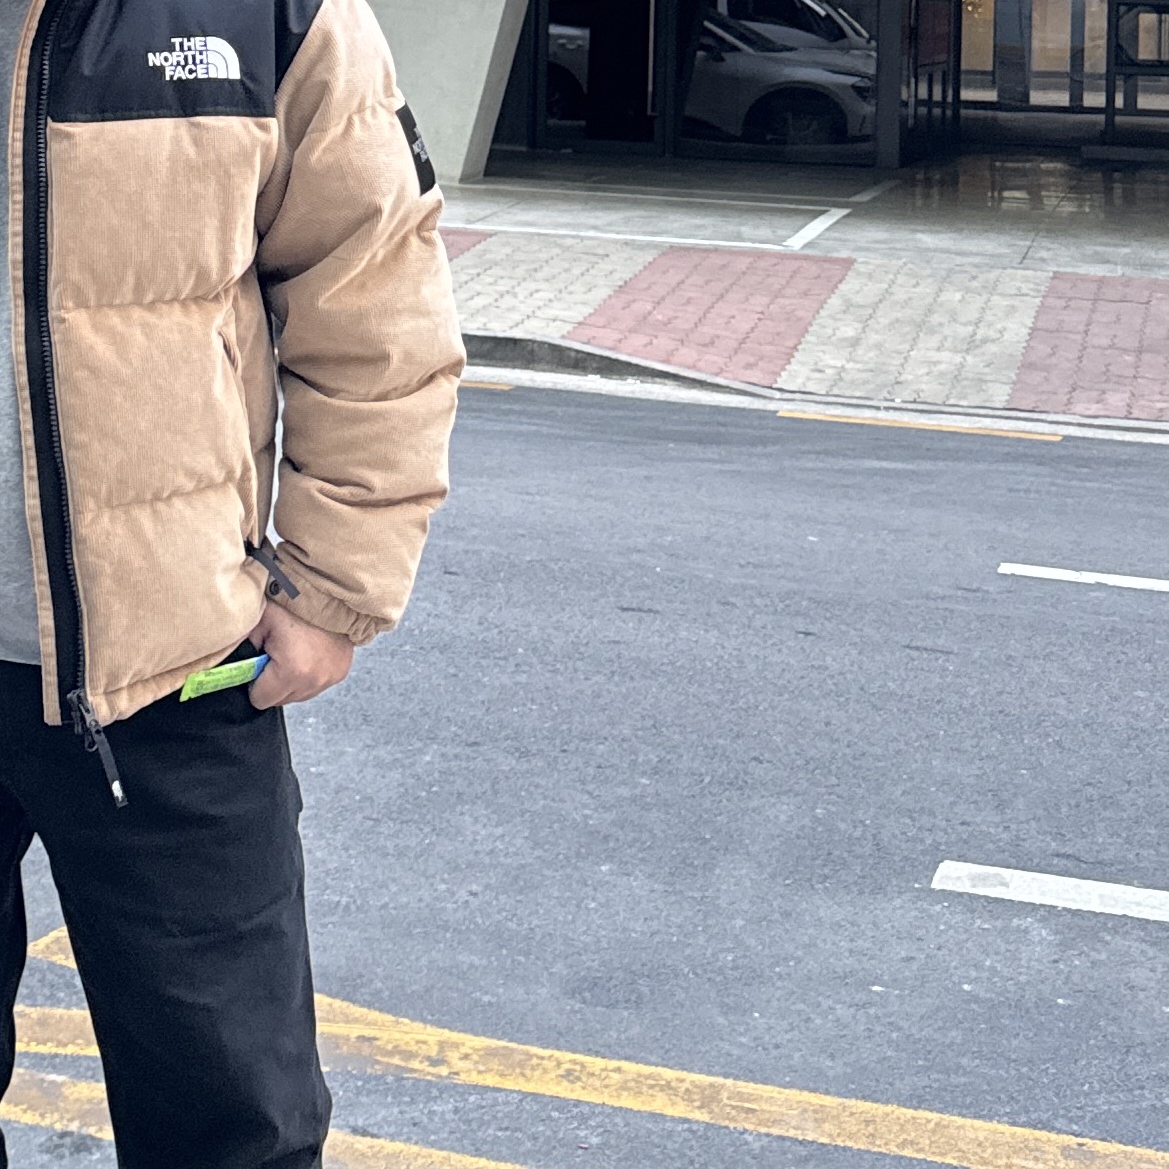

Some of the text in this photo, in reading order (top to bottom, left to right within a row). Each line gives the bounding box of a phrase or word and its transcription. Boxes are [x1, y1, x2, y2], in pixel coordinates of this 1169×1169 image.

[170, 37, 207, 52] THE
[147, 50, 208, 67] NORTH
[165, 64, 209, 81] FACE
